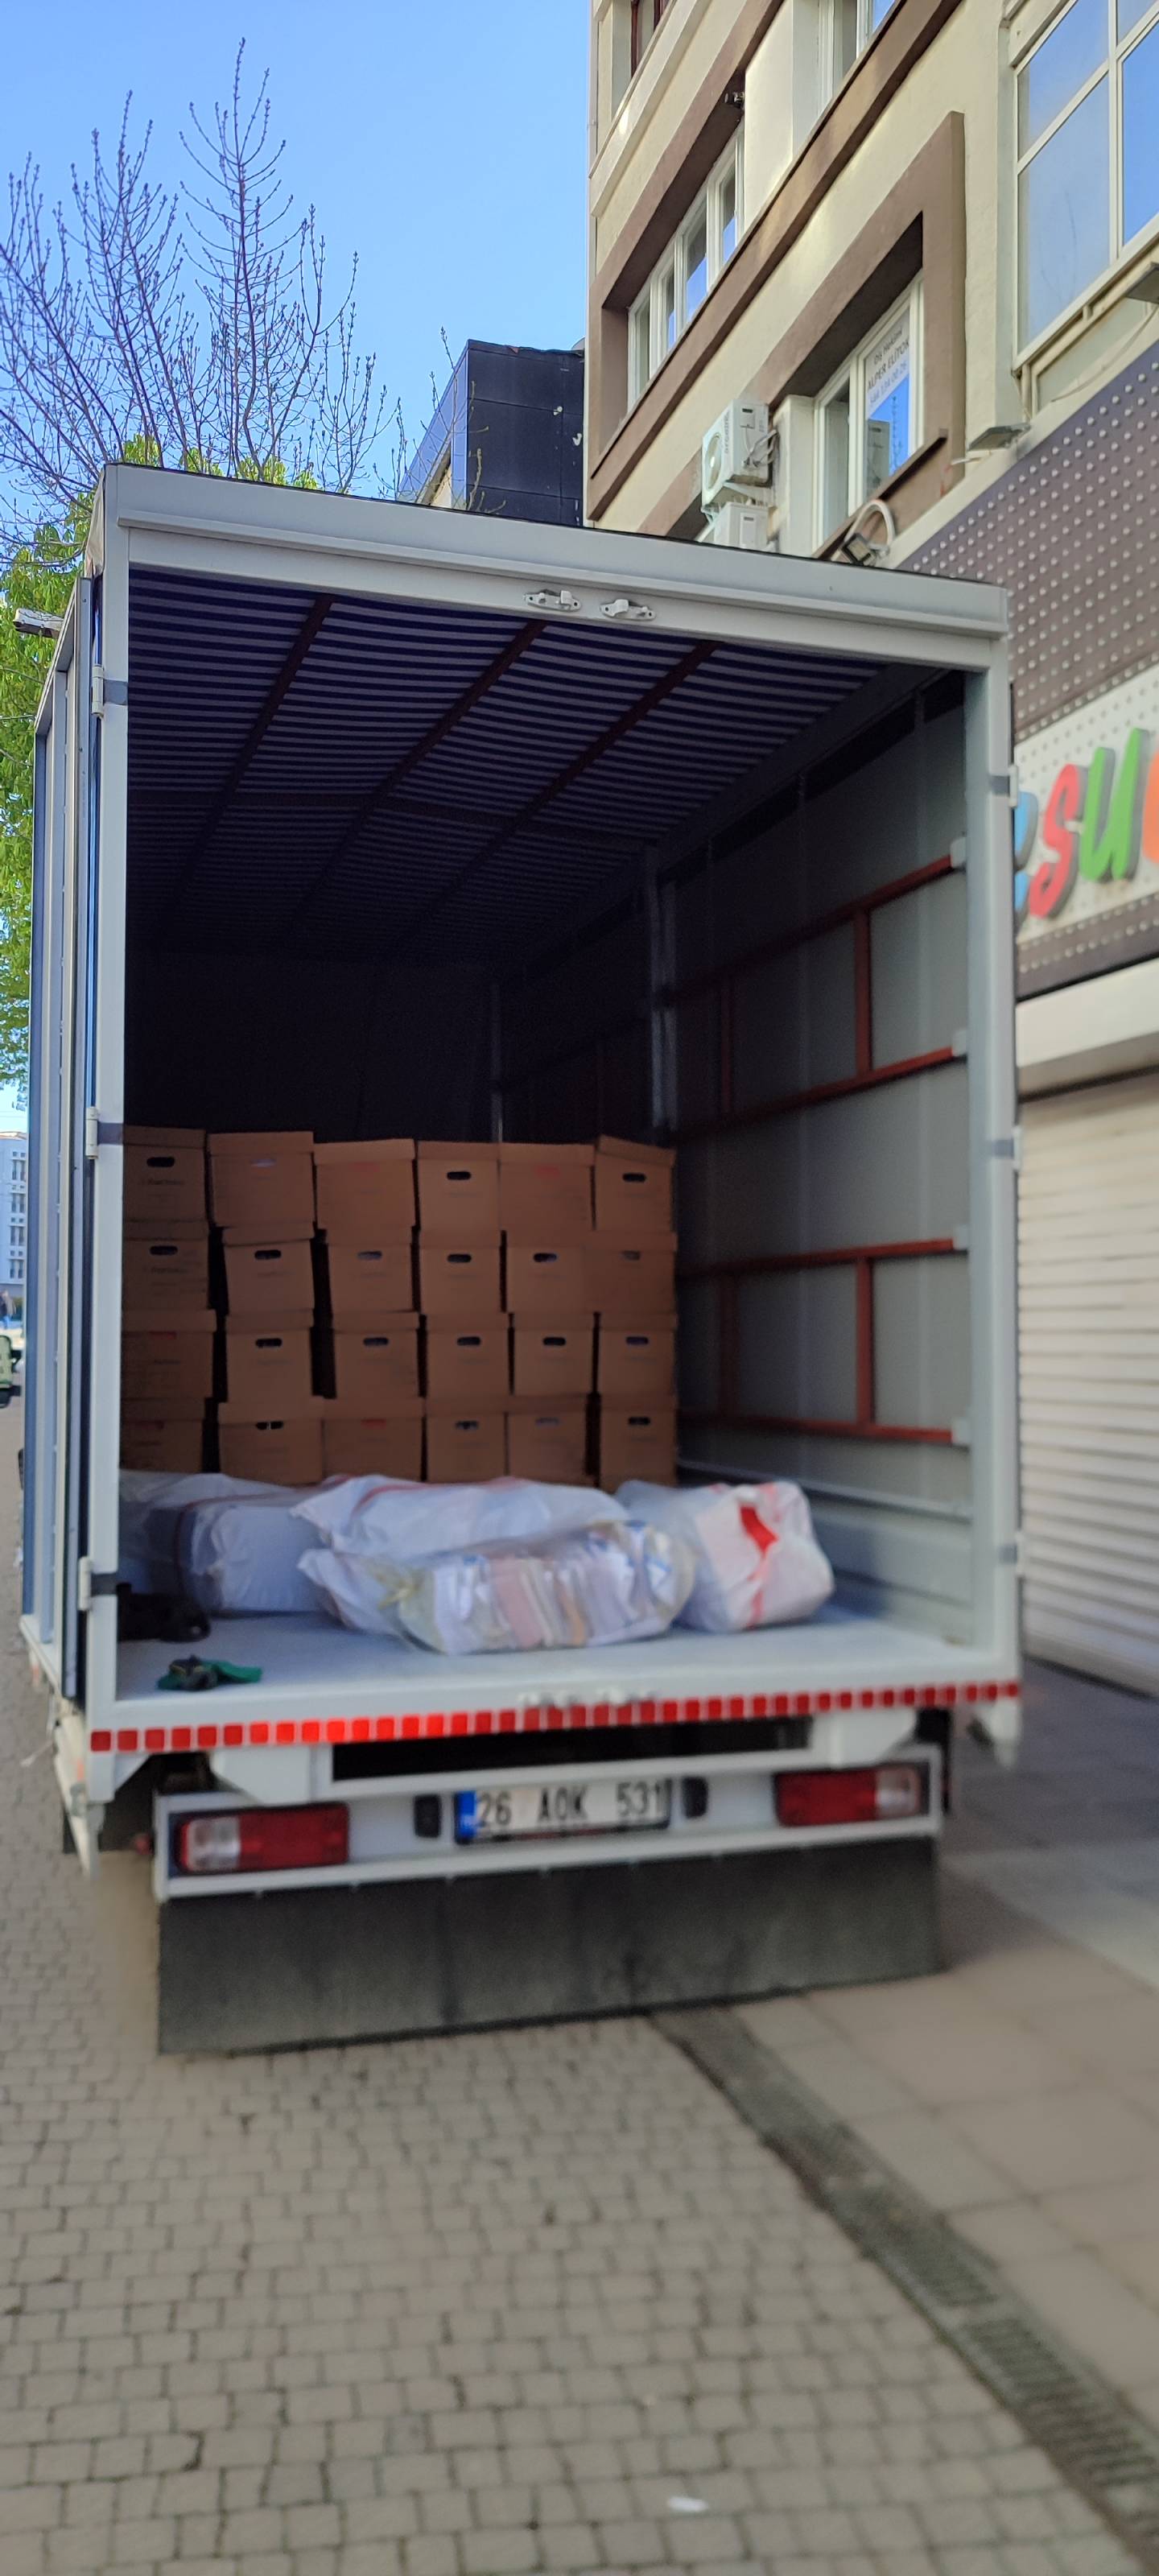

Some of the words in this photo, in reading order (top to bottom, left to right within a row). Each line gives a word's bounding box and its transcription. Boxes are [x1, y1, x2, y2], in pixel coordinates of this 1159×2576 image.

[868, 363, 886, 392] ALPER
[478, 1790, 512, 1828] 26
[615, 1776, 663, 1816] 531
